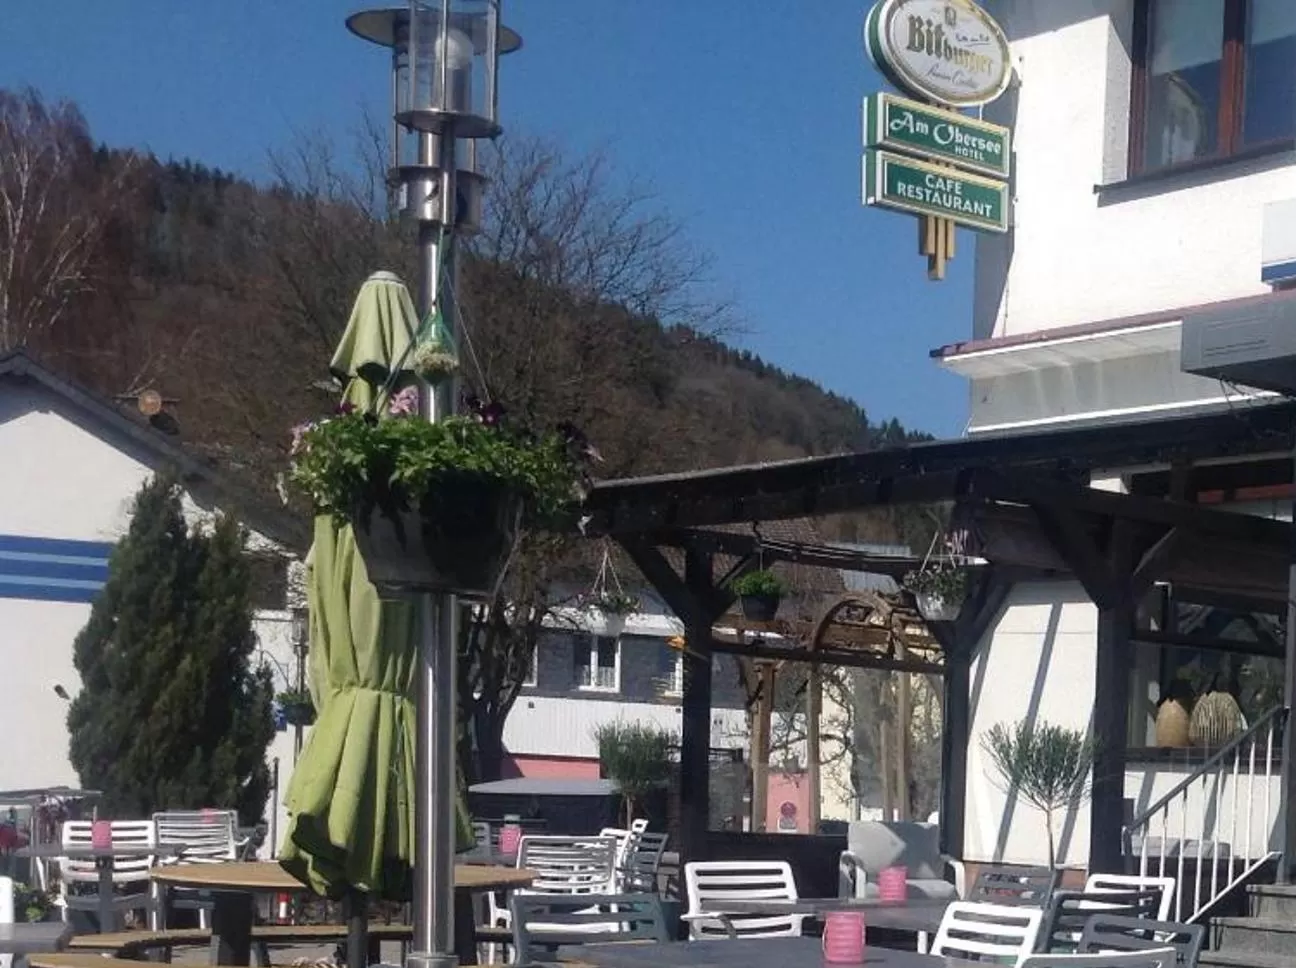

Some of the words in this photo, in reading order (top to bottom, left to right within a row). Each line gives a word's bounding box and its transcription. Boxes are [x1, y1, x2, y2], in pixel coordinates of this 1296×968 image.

[906, 13, 993, 77] Bitburger
[890, 112, 929, 135] Am
[933, 123, 1002, 154] Obersee
[955, 145, 985, 161] HOTEL
[897, 181, 993, 217] RESTAURANT
[925, 174, 962, 196] CAFE
